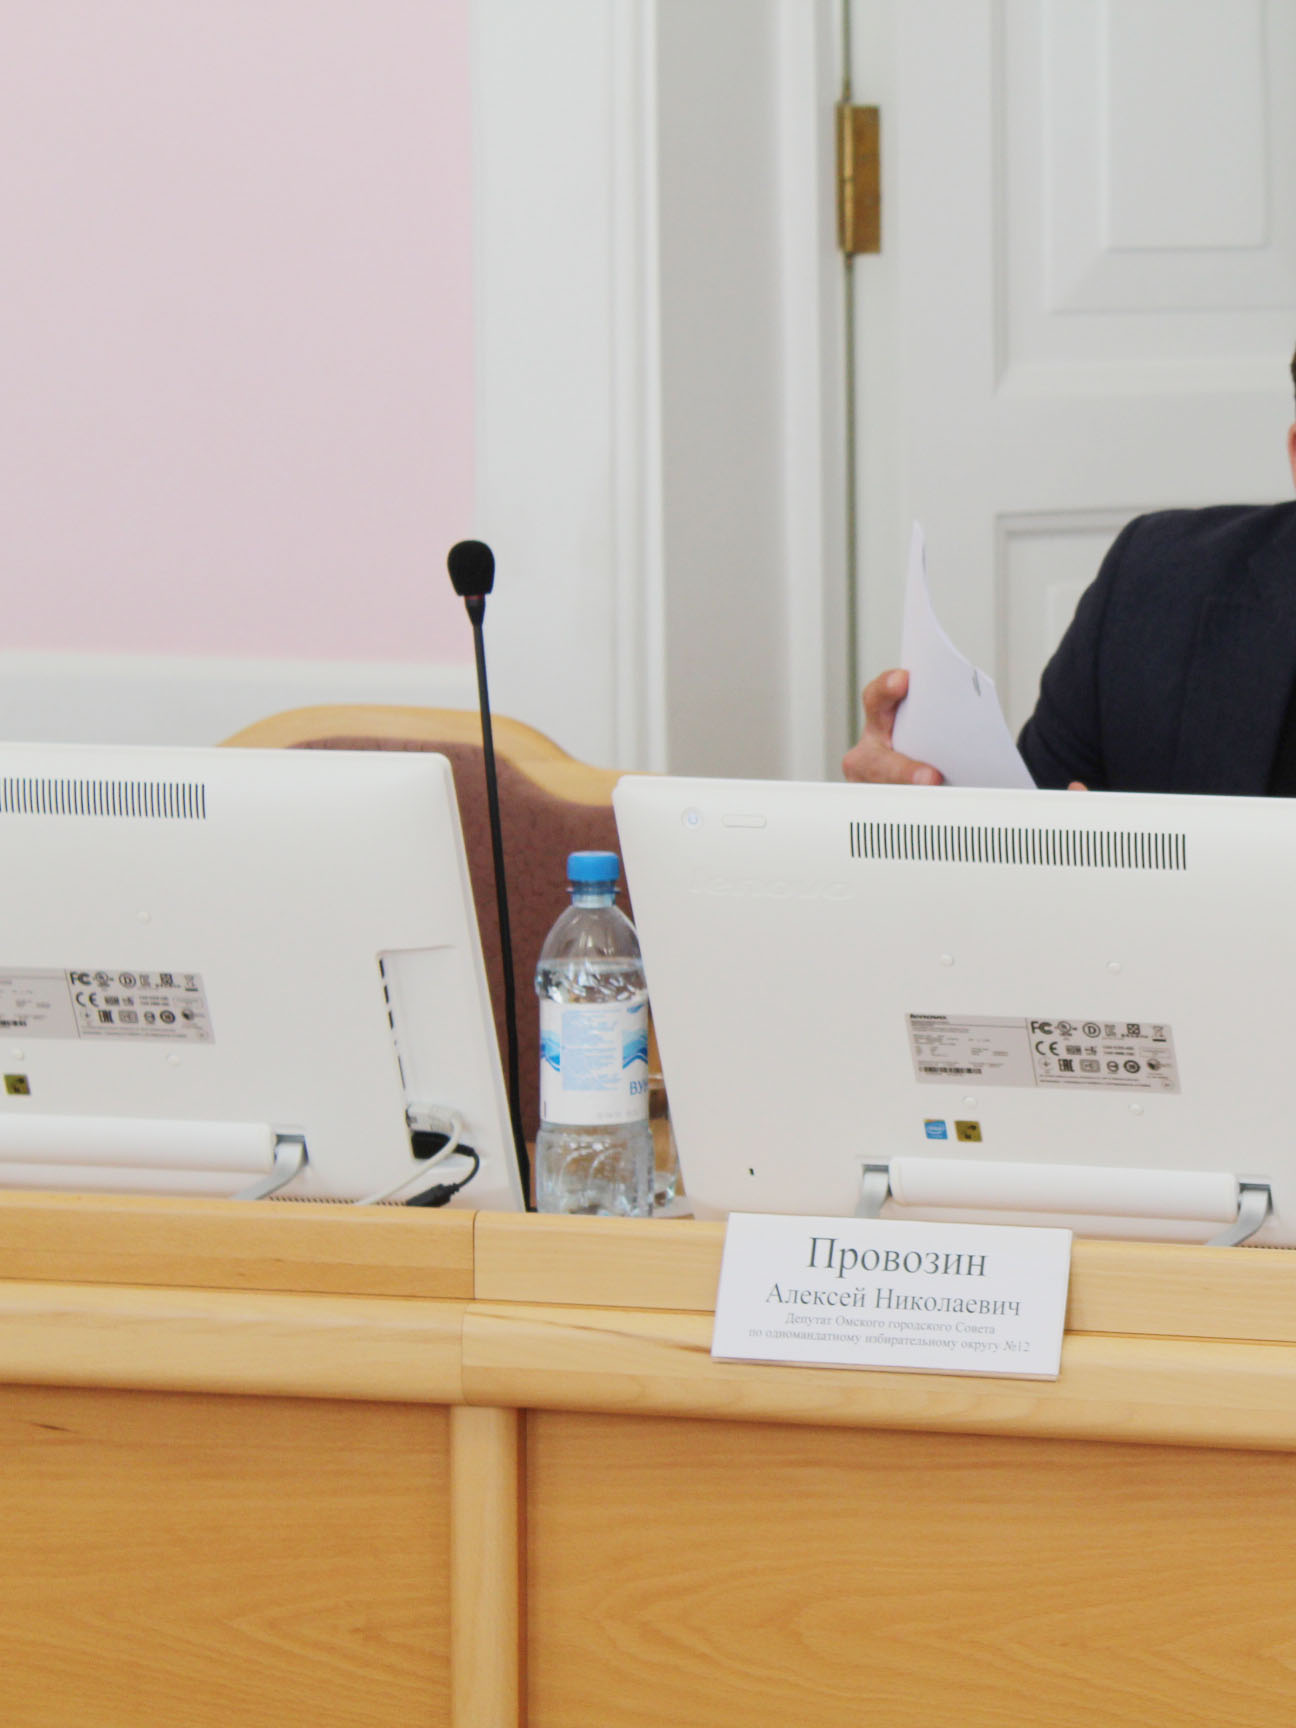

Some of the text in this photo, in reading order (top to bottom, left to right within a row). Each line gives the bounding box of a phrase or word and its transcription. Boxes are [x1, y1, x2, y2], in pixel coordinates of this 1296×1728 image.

[807, 1236, 988, 1279] Провозин
[765, 1283, 1023, 1316] Алексей Николаевич
[785, 1312, 996, 1335] Депутат Омского городского Совета
[748, 1329, 1032, 1353] по одномандатному избирательному округу №12
